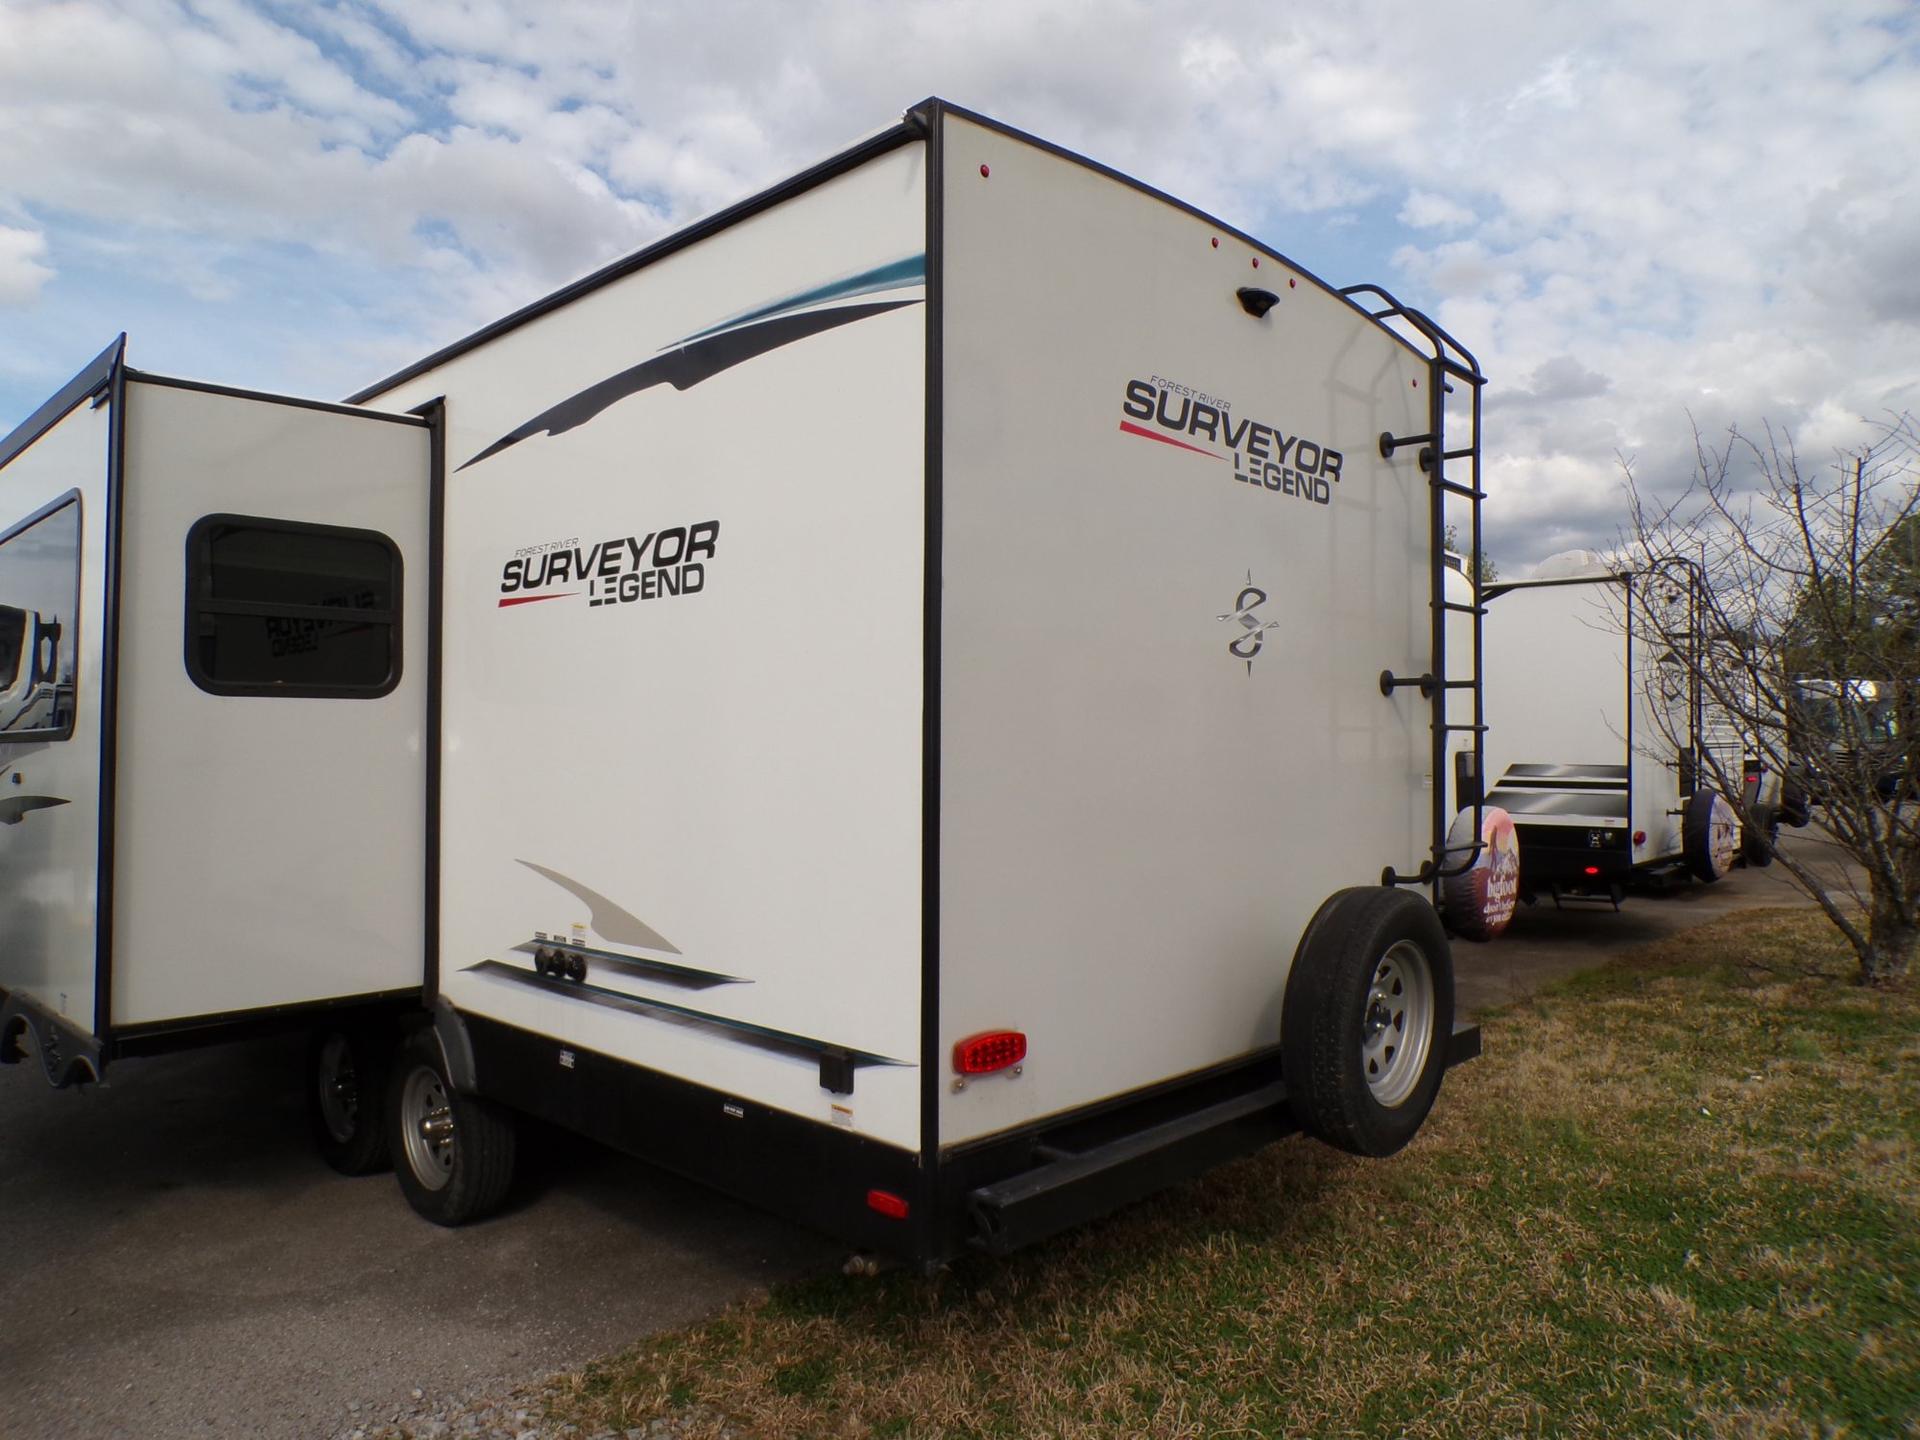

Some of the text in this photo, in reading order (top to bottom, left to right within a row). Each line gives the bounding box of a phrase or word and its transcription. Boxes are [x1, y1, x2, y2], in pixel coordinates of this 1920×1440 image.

[1150, 375, 1231, 411] FOREST RIVER
[1123, 379, 1343, 483] SURVEYOR
[1234, 452, 1330, 505] LEGEND
[501, 520, 720, 593] SURVEYOR
[514, 537, 579, 558] FOREST RIVER
[589, 562, 704, 607] LEGEND
